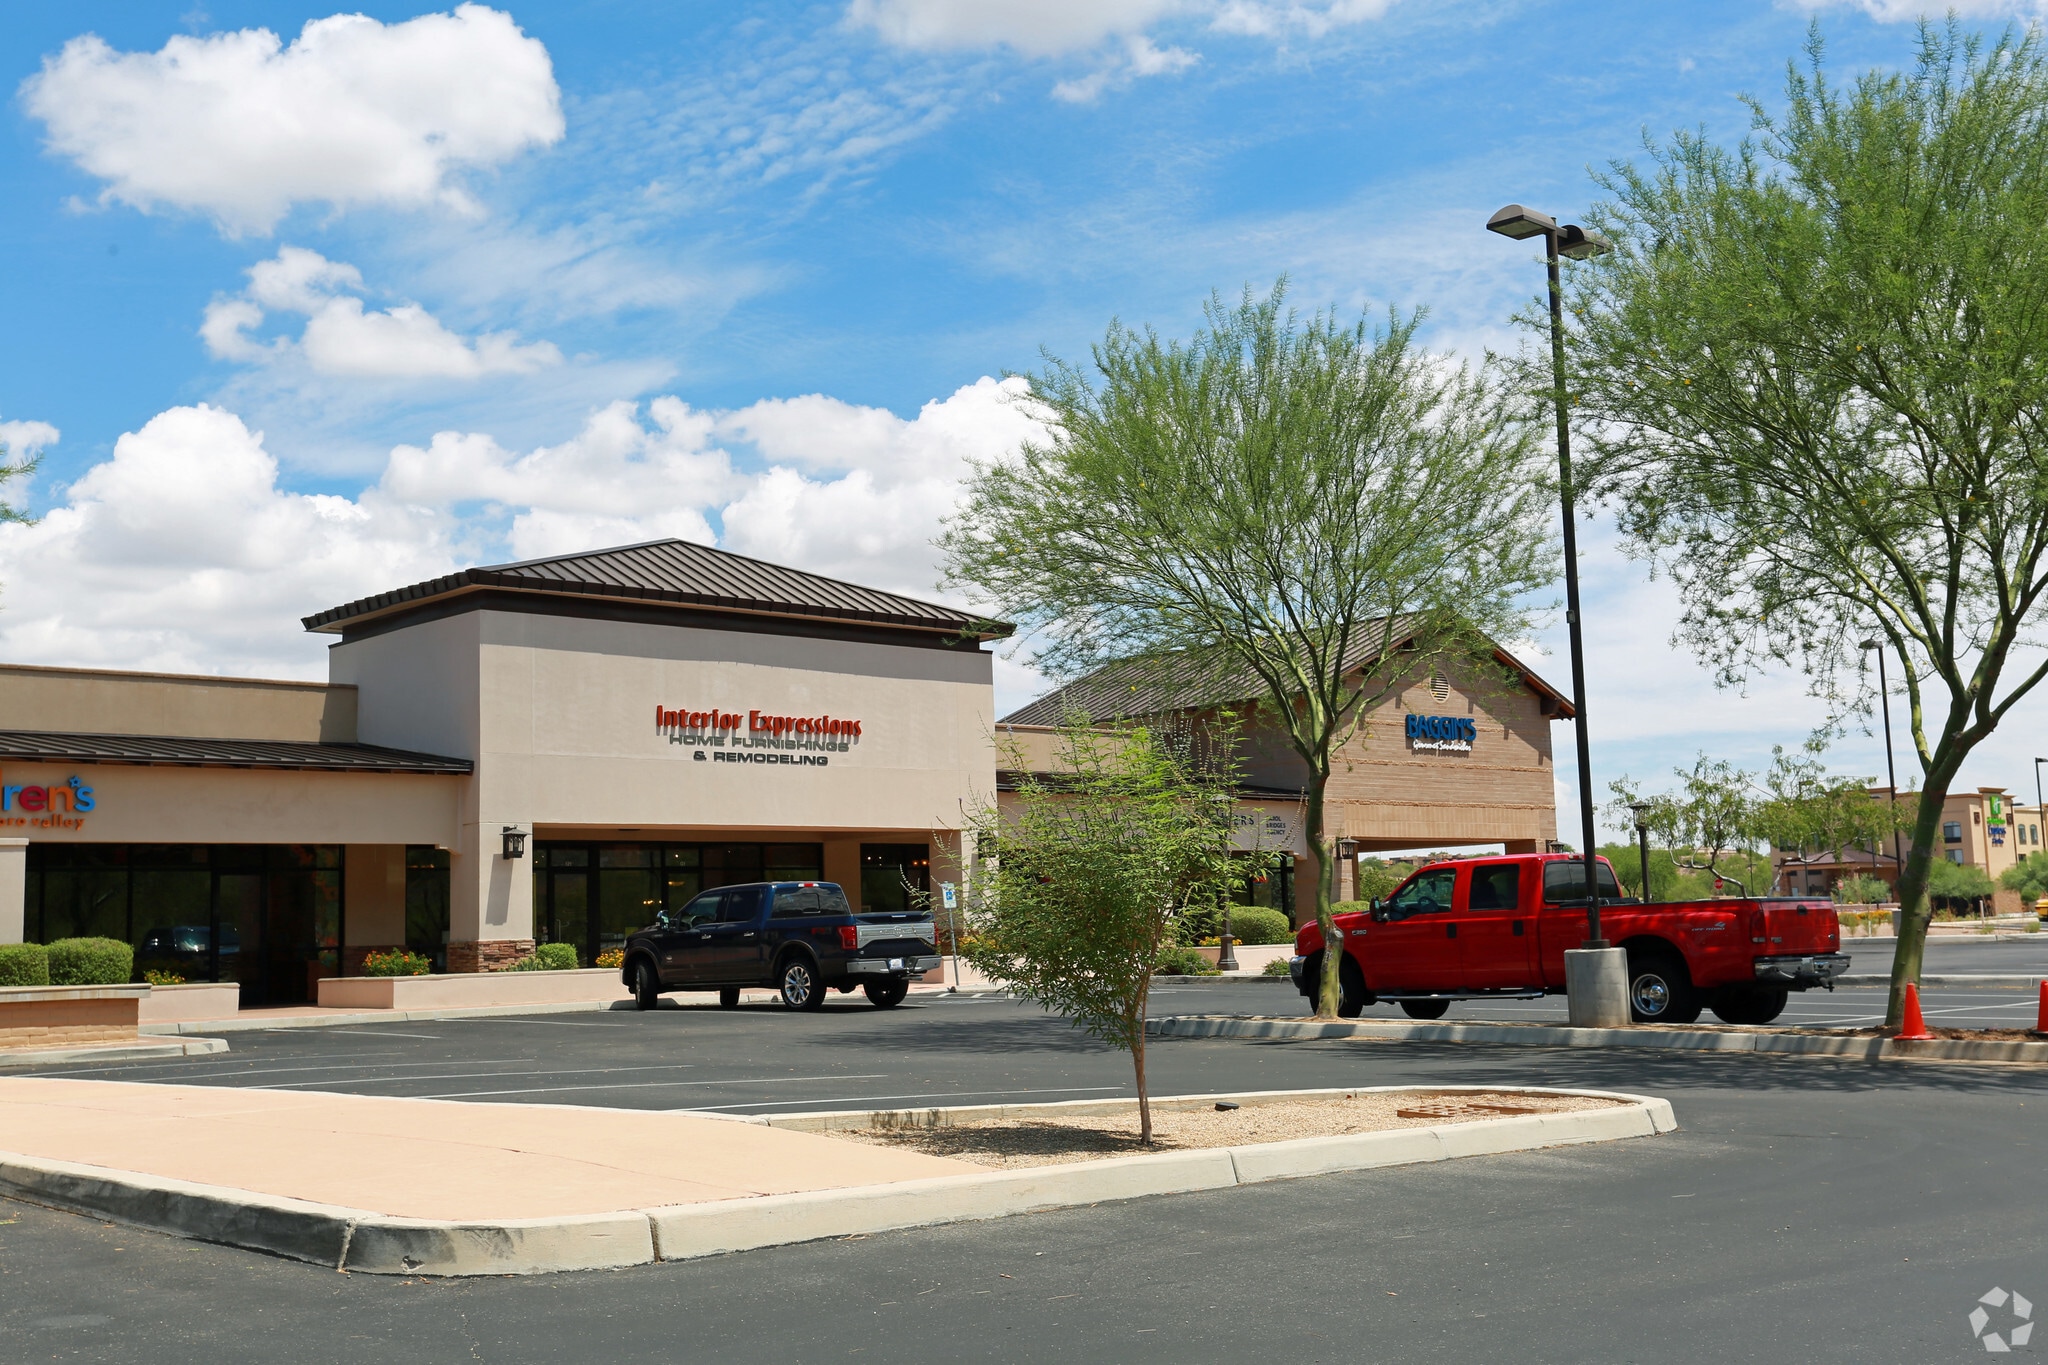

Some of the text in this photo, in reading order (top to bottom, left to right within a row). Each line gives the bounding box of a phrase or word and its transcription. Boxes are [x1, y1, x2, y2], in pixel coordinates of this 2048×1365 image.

[656, 705, 862, 736] Interior Expressions
[669, 734, 850, 752] HOME FURNISHINGS
[693, 751, 829, 766] & REMODELING
[0, 768, 96, 812] ren's
[31, 814, 85, 831] valley
